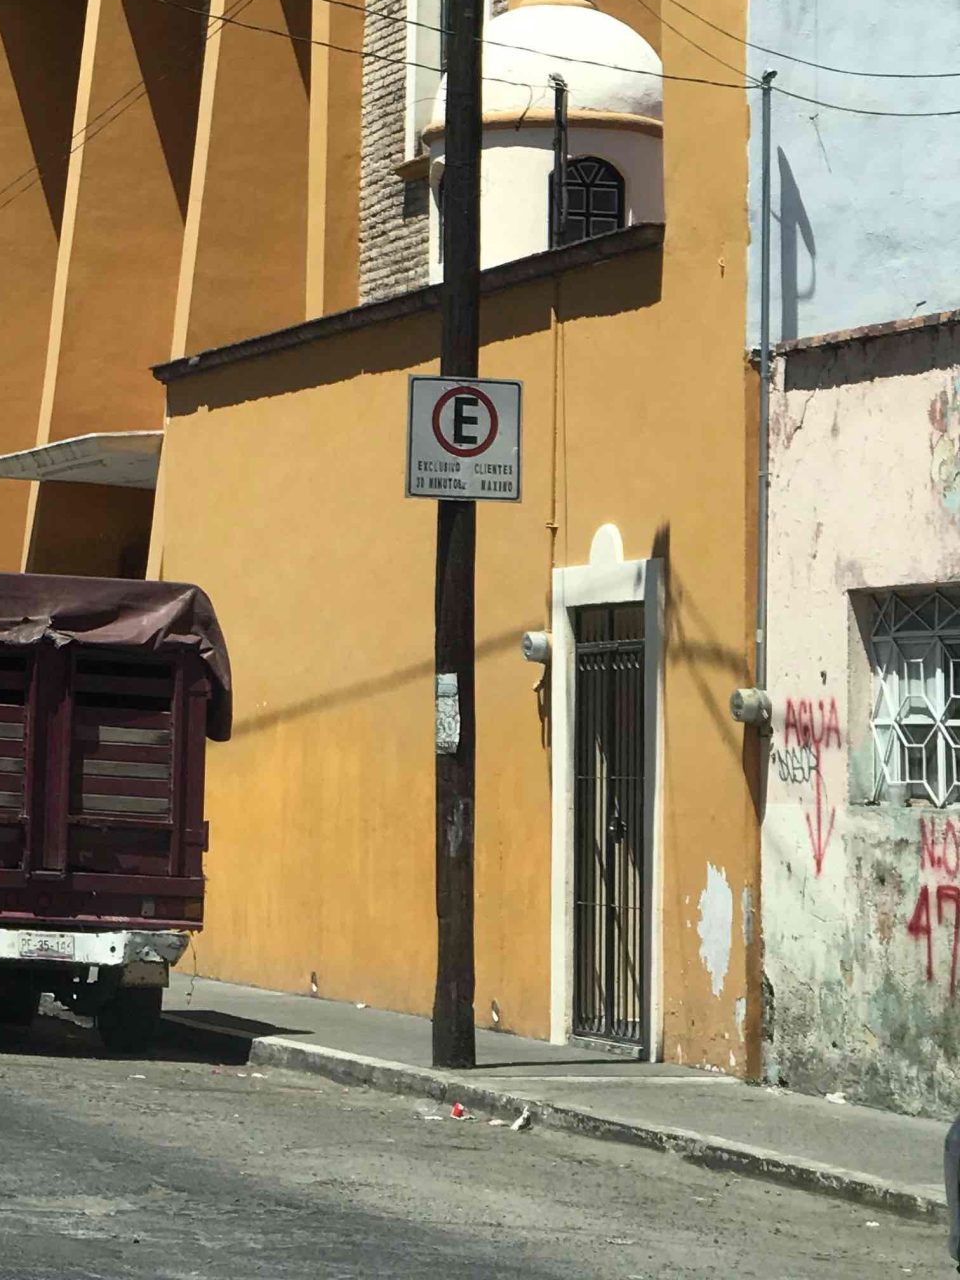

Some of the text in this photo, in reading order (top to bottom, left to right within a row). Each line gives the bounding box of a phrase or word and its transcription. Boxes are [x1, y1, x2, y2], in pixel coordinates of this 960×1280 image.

[453, 396, 479, 445] E
[417, 460, 513, 475] EXCLUSIVO CLIENTES
[784, 697, 842, 750] AGUA
